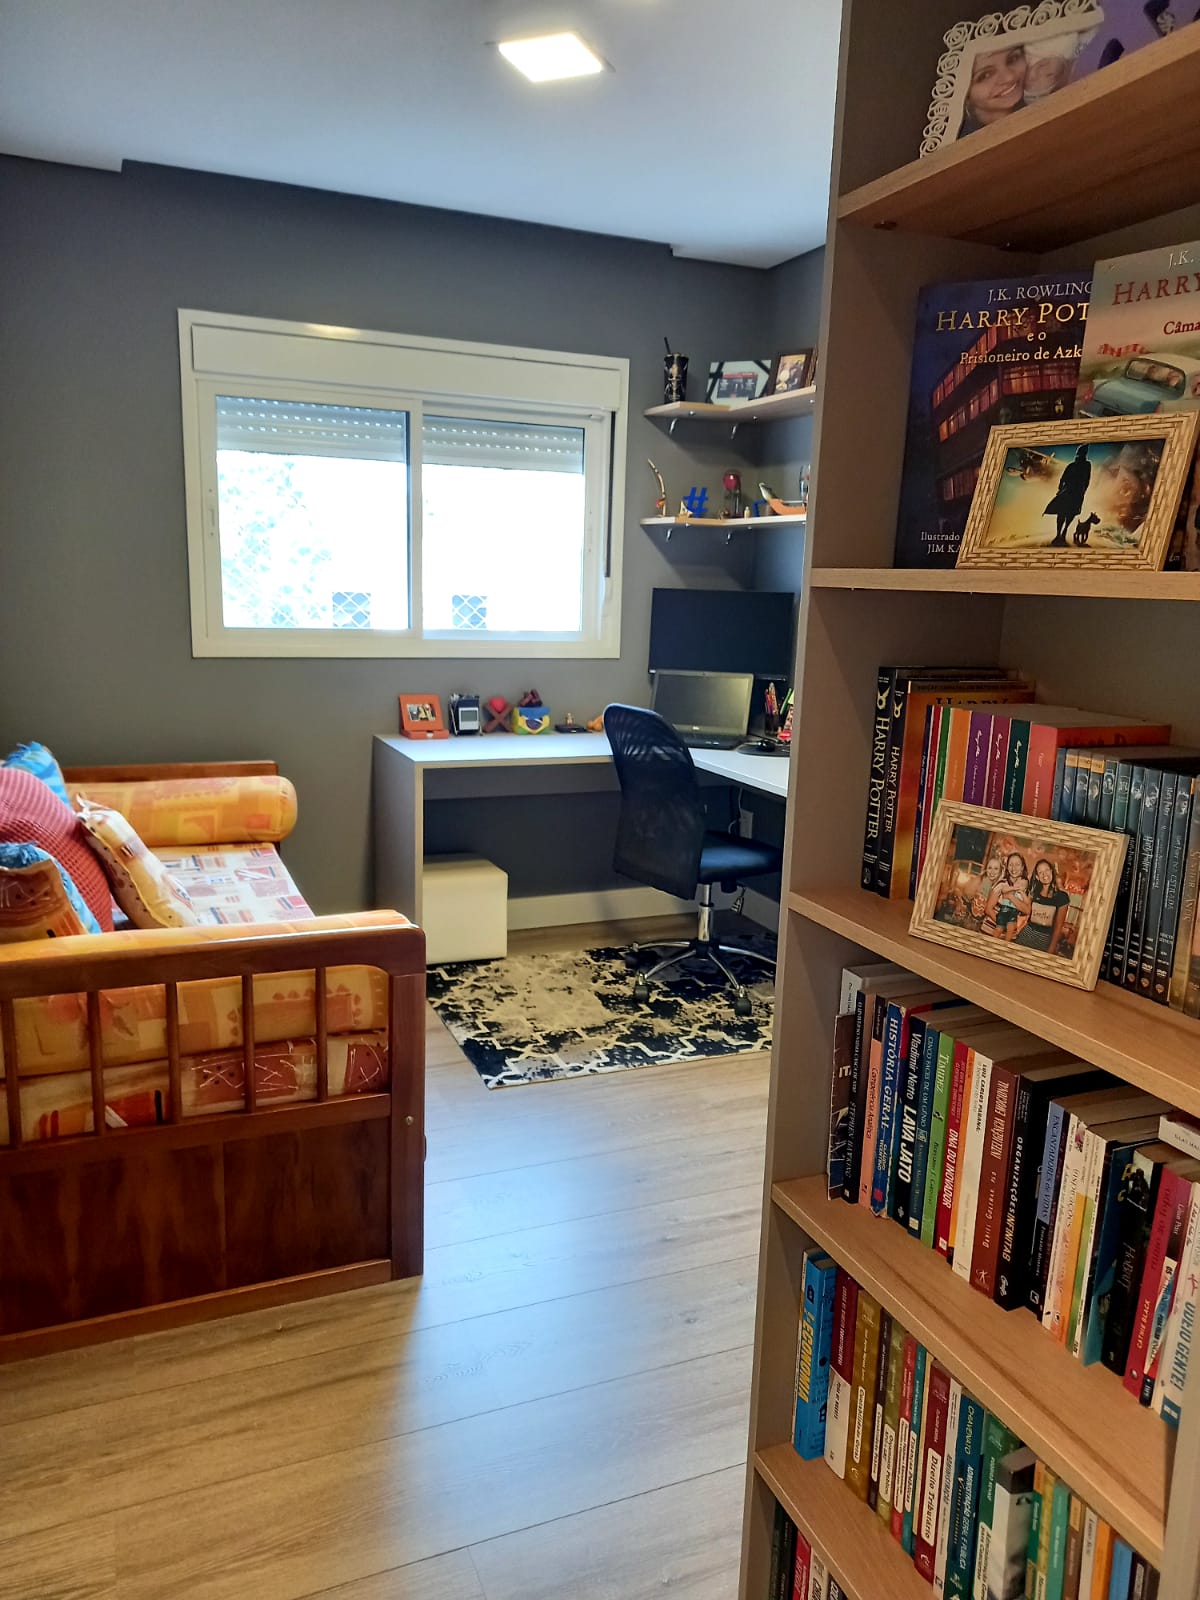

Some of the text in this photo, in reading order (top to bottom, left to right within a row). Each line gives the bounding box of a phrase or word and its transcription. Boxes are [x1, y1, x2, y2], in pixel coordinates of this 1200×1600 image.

[1168, 250, 1194, 272] J.K.
[987, 287, 1011, 304] J.K.
[1112, 272, 1200, 306] HARRY
[936, 302, 1090, 331] HARRY POT
[1027, 331, 1047, 342] e o
[959, 350, 1030, 365] Prisioneiro
[1034, 348, 1050, 360] de
[920, 531, 960, 542] Ilustrado
[927, 544, 944, 554] JIM
[865, 716, 889, 839] HARRY POTTER
[883, 746, 900, 832] HARRY POTTER
[926, 1036, 934, 1058] CINCO
[881, 1017, 899, 1129] HISTÓRIA GERAL
[923, 1081, 929, 1090] DE
[935, 1053, 949, 1093] TIMIDEZ
[898, 1032, 921, 1182] Vladimir Netto LAVA JATO
[922, 1092, 928, 1103] UM
[919, 1105, 928, 1127] GÊNIO
[1044, 1115, 1061, 1180] ENCANTADORES
[941, 1129, 958, 1208] DNA DO INOVADOR
[1007, 1136, 1023, 1213] ORGANIZAÇÕES
[1040, 1194, 1051, 1217] VIDAS
[1136, 1298, 1150, 1348] CATHIE BLACK
[1170, 1301, 1196, 1391] ODEIO GENTE!
[855, 1389, 865, 1437] Contabilidade
[963, 1405, 975, 1454] CHIAVENATO
[908, 1437, 916, 1469] Finanças
[924, 1455, 938, 1537] Direito Tributário
[962, 1464, 976, 1516] ADMINISTRAÇÃO
[961, 1517, 969, 1536] GERAL
